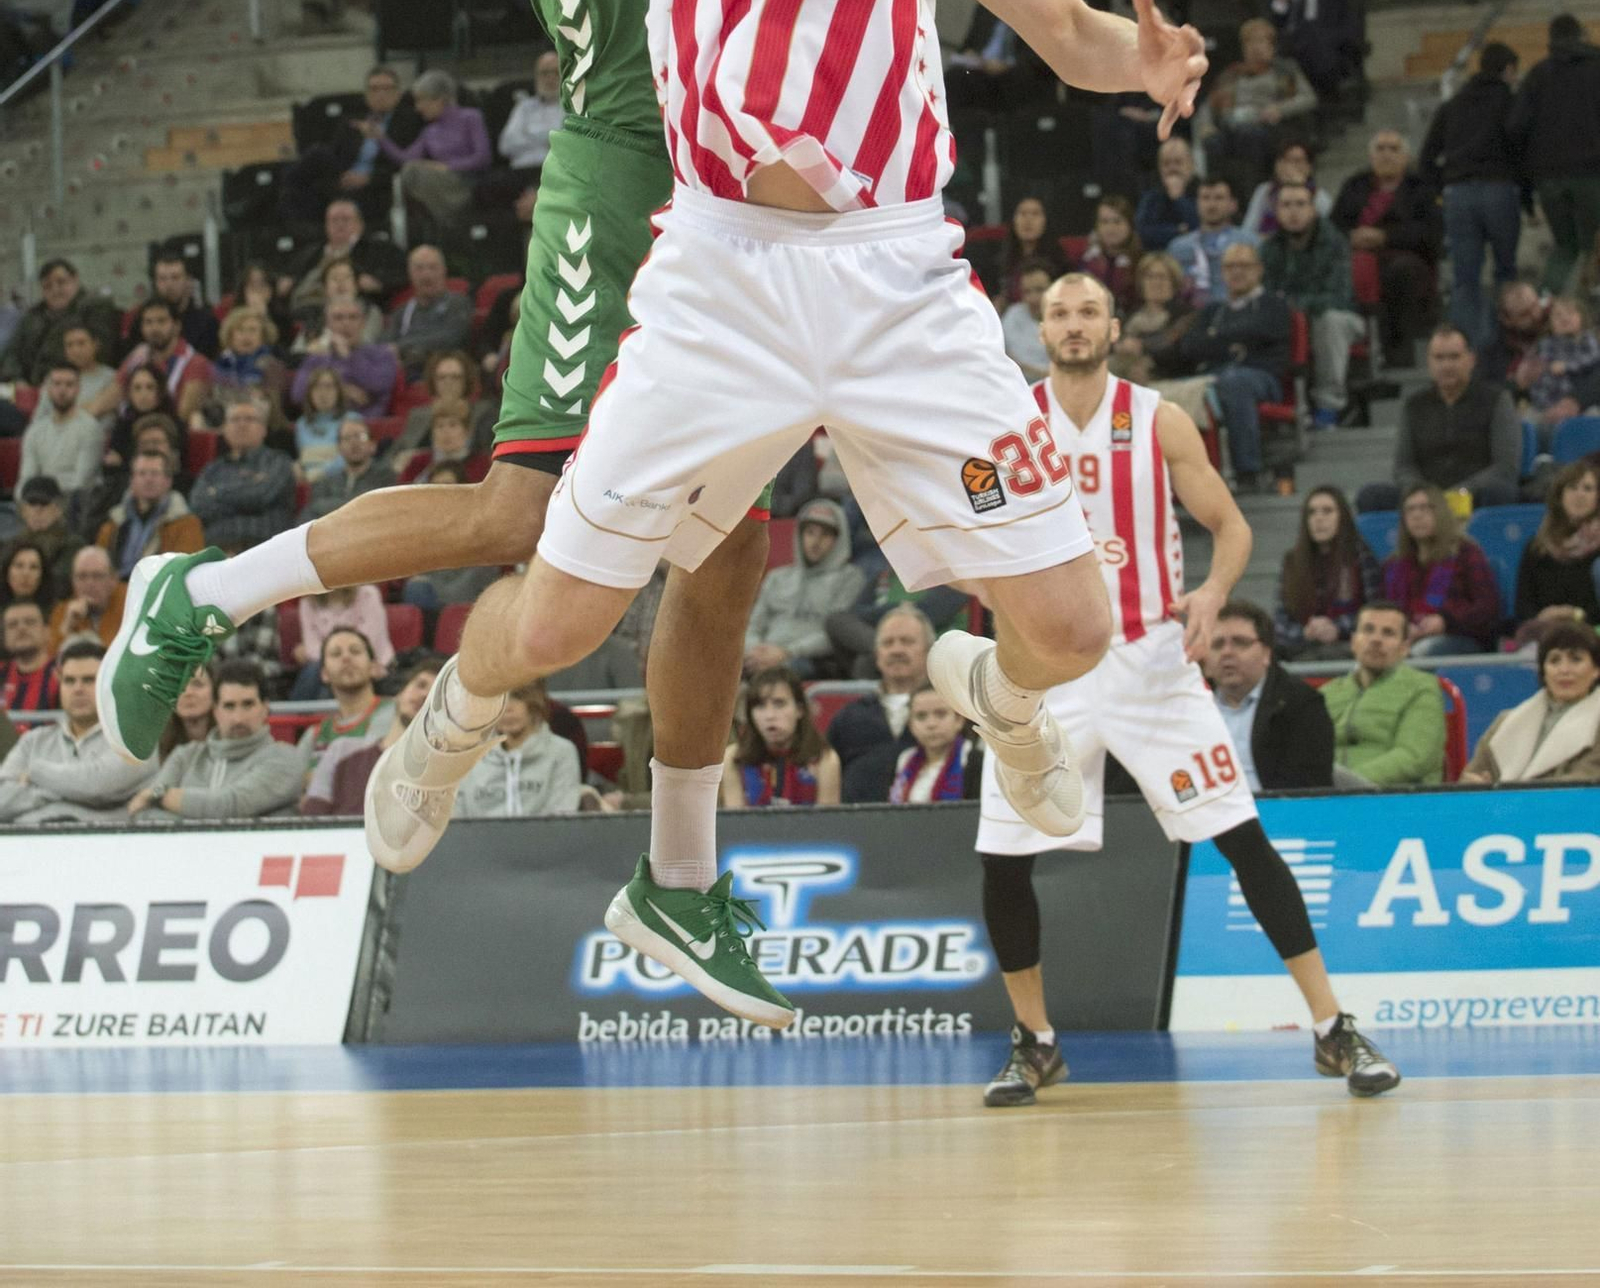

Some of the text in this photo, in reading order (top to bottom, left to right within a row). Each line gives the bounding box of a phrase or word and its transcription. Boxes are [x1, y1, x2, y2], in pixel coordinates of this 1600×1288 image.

[988, 416, 1071, 498] 32
[1192, 743, 1237, 789] 19
[1357, 831, 1600, 928] ASP
[0, 899, 291, 983] RREO
[588, 931, 968, 980] POERADE
[53, 1013, 138, 1037] ZURE
[147, 1012, 266, 1037] BAITAN
[578, 1010, 689, 1042] bebida
[780, 1007, 972, 1037] deportistas
[1375, 993, 1600, 1027] aspypreven
